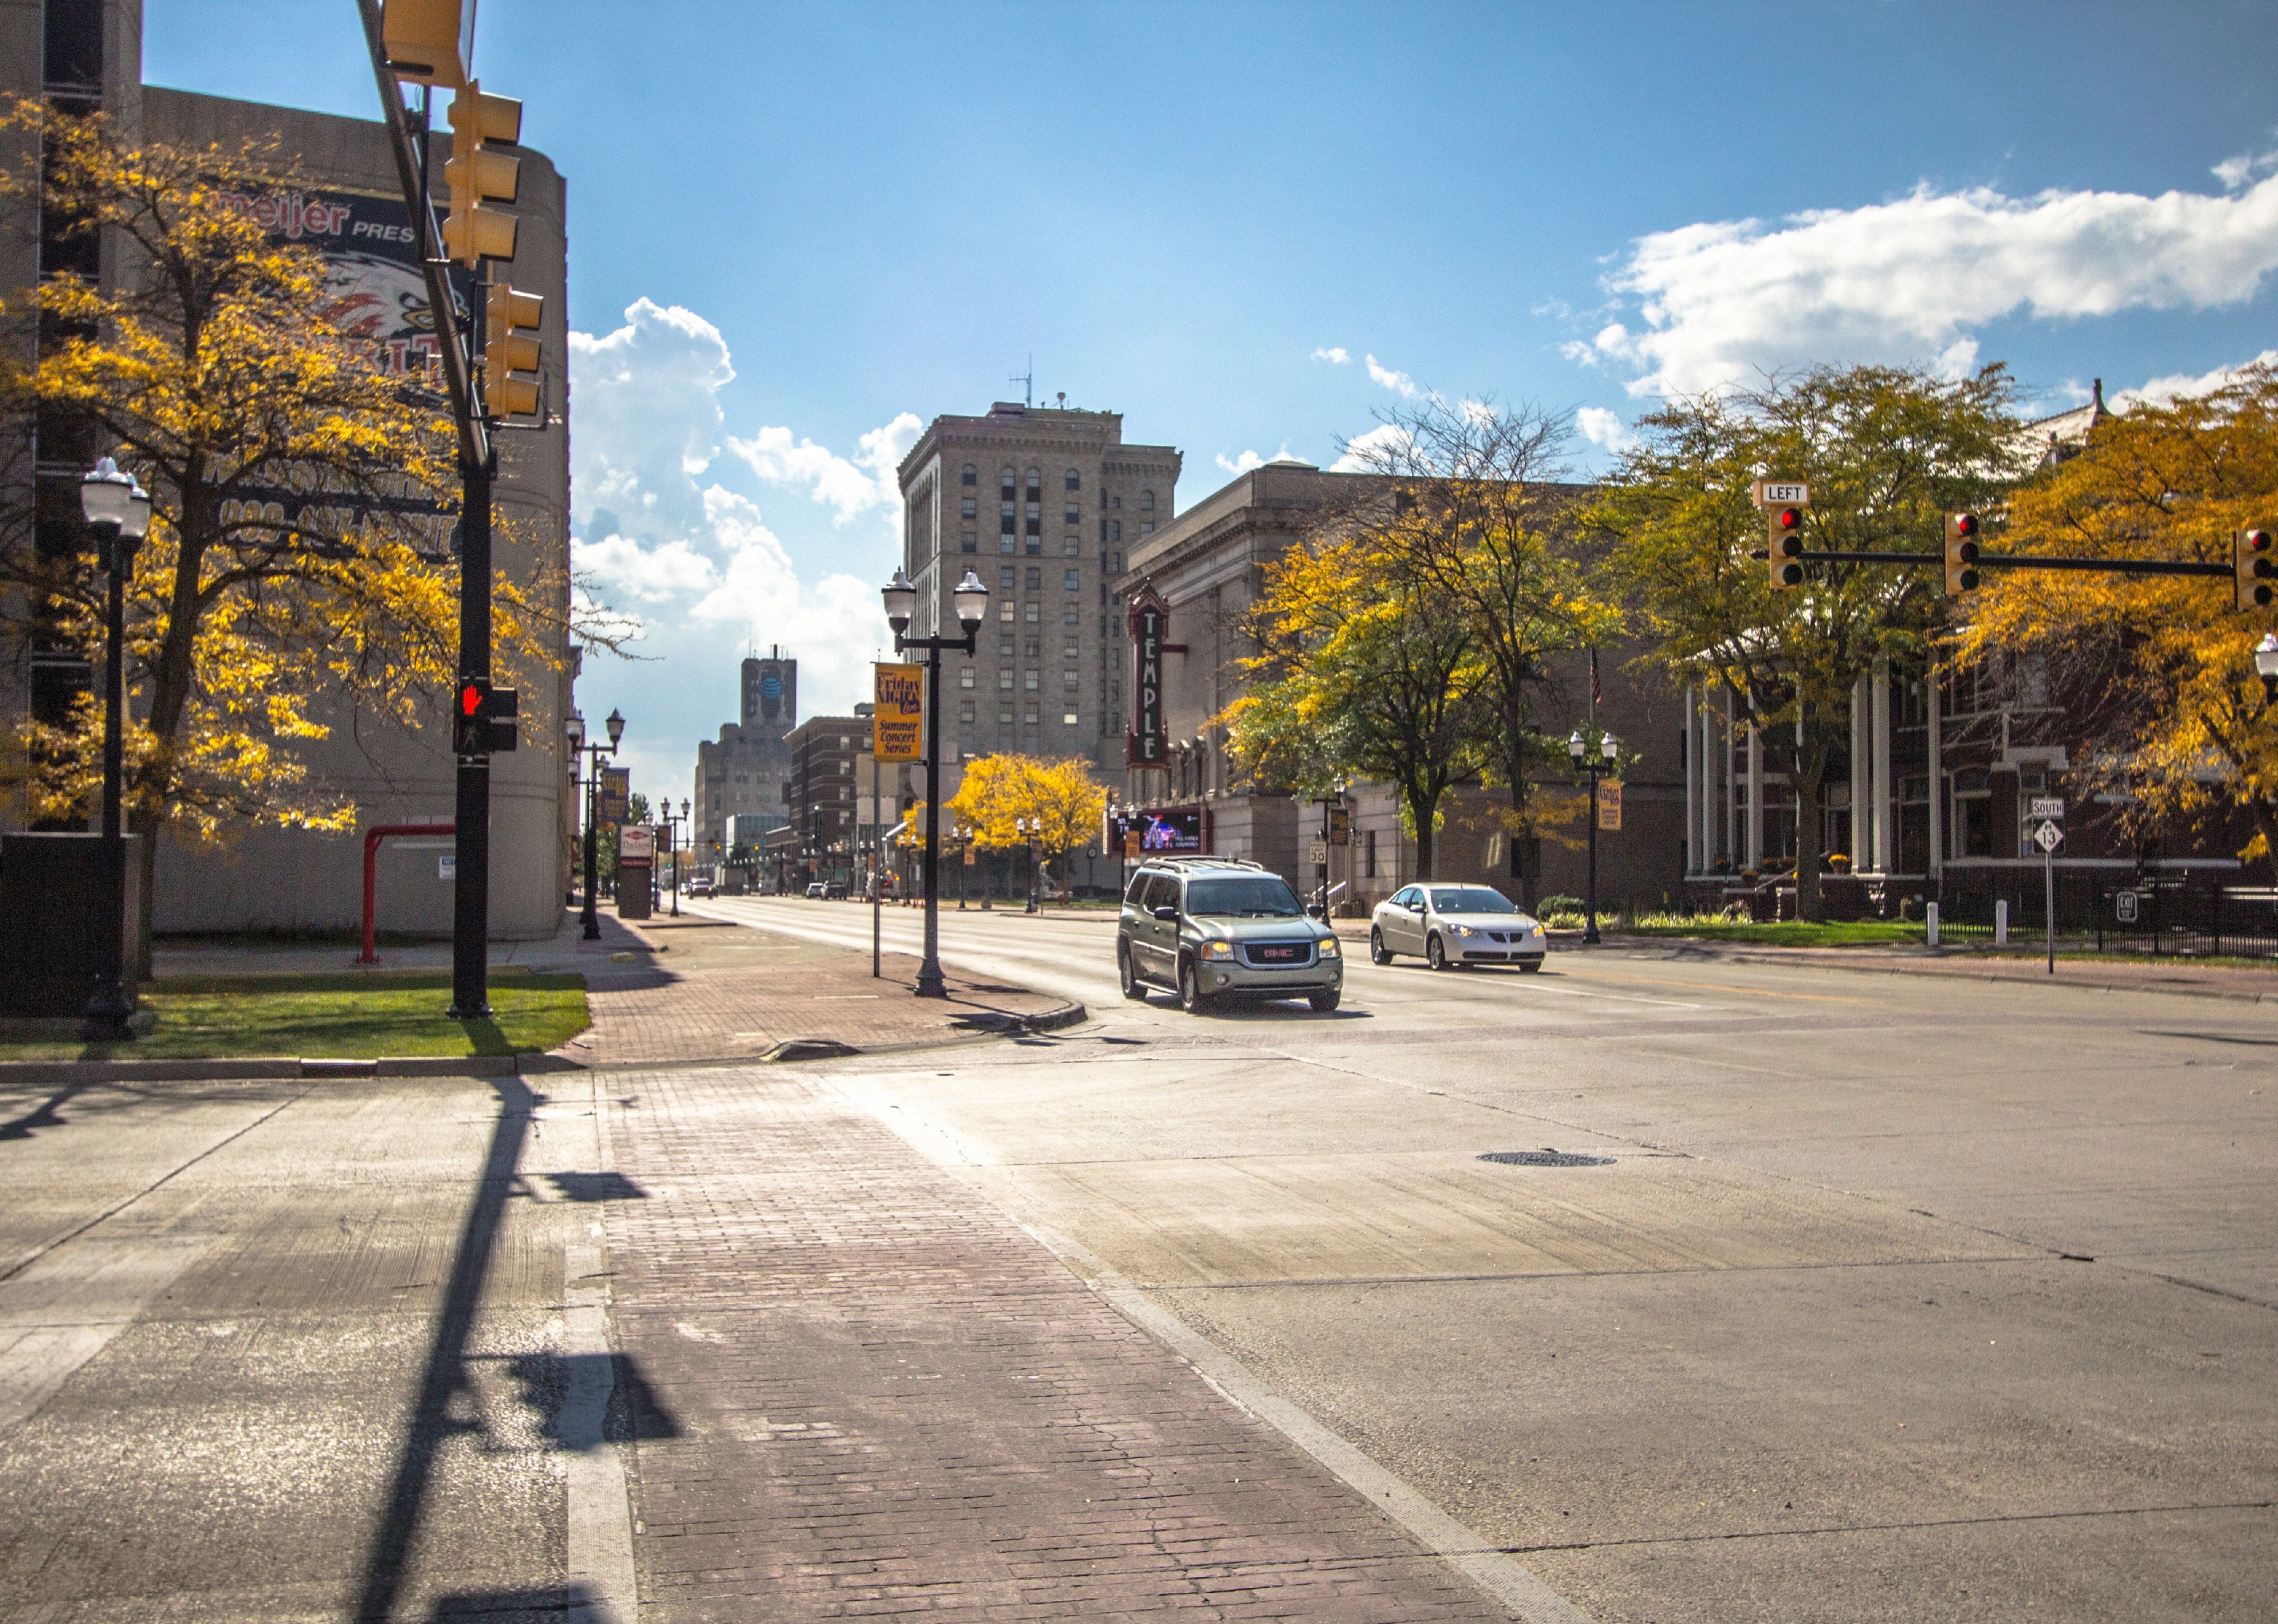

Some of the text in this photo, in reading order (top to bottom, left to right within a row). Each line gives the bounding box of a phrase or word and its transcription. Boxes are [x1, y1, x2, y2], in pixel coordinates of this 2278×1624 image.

[1768, 486, 1801, 500] LEFT
[877, 676, 920, 696] Friday
[1143, 613, 1156, 758] TEMPLE
[879, 720, 918, 732] Summer
[880, 731, 916, 743] Concert
[885, 742, 912, 754] Series
[2034, 802, 2063, 814] SOUTH
[2042, 831, 2056, 845] 13
[1311, 852, 1325, 861] 30
[1264, 949, 1293, 957] GMC
